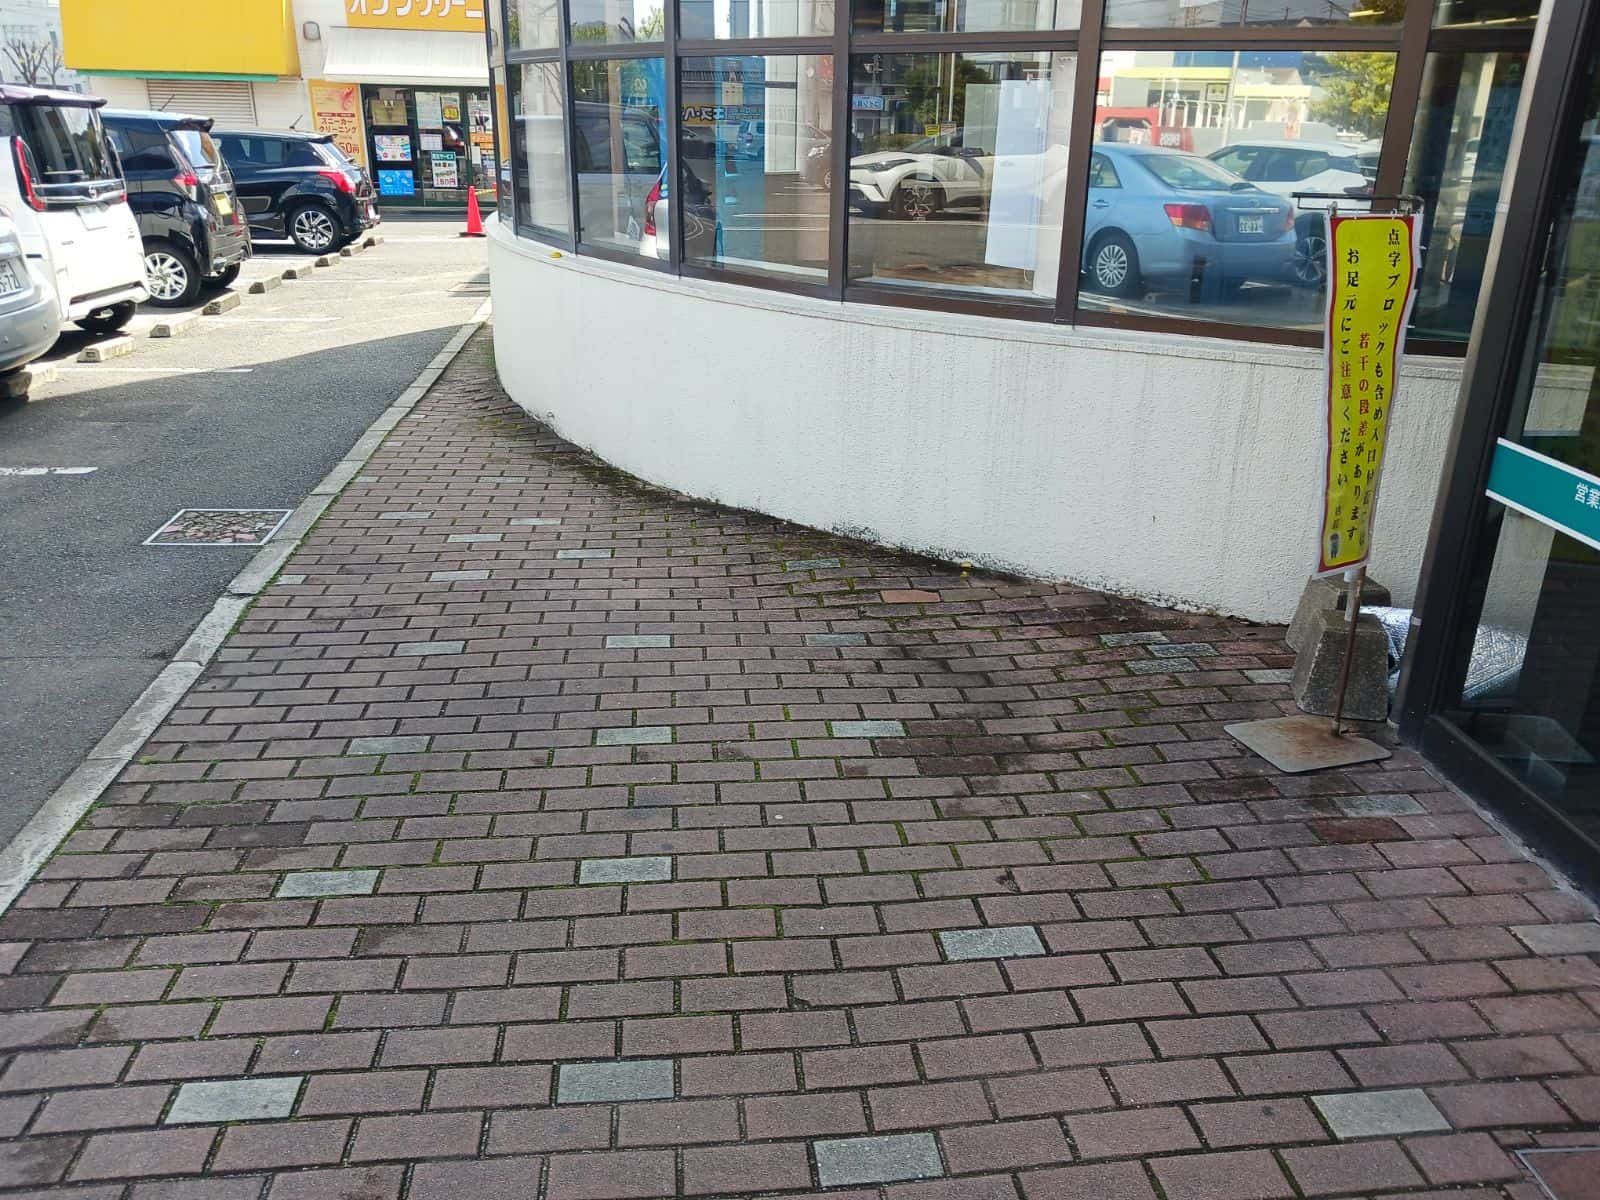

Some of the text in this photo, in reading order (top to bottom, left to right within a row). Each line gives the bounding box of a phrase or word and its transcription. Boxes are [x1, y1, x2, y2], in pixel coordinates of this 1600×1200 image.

[1337, 248, 1360, 486] お足元にご注意ください
[1347, 332, 1371, 540] 若干の段差があります
